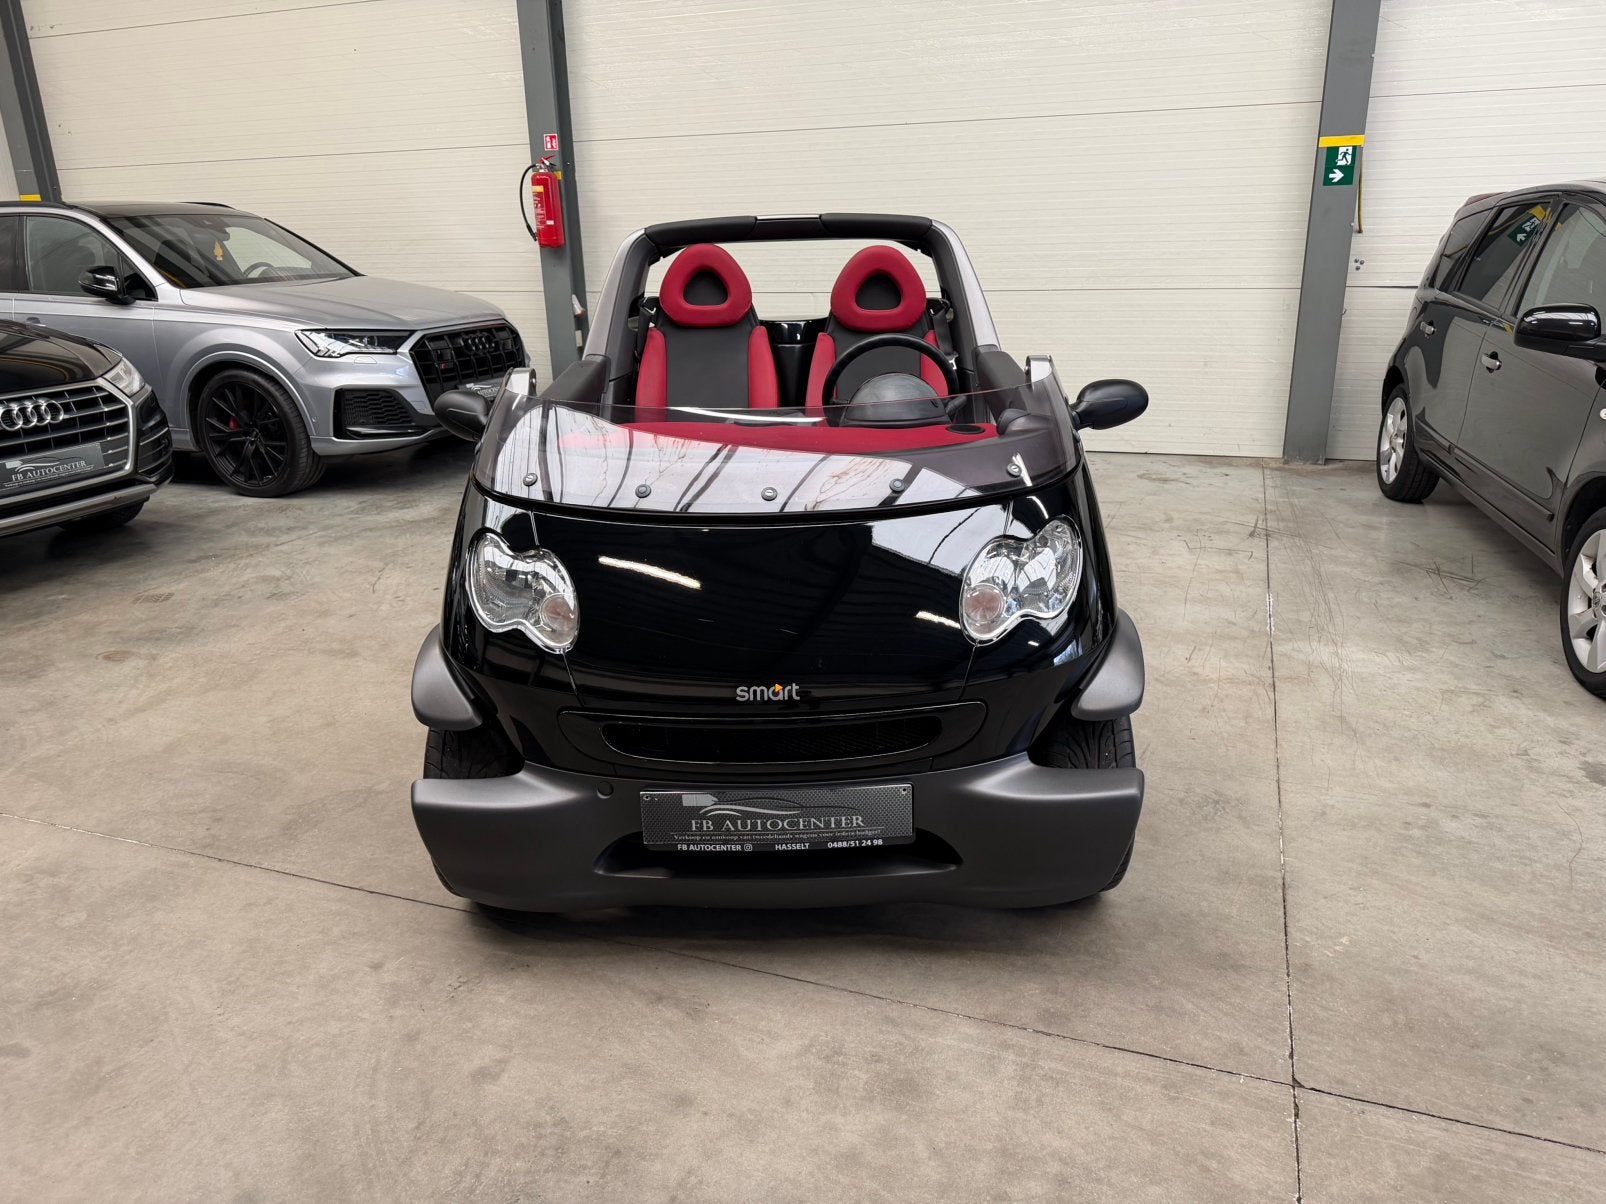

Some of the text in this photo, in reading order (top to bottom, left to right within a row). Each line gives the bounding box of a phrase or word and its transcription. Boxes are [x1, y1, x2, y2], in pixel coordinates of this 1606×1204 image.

[12, 474, 24, 482] FB
[26, 460, 87, 478] AUTOCENTER
[735, 683, 801, 702] smart
[690, 816, 865, 831] FB AUTOCENTER
[677, 843, 742, 851] FB AUTOCENTER
[775, 842, 810, 851] HASSELT
[827, 838, 883, 849] 0488/51 24 98
